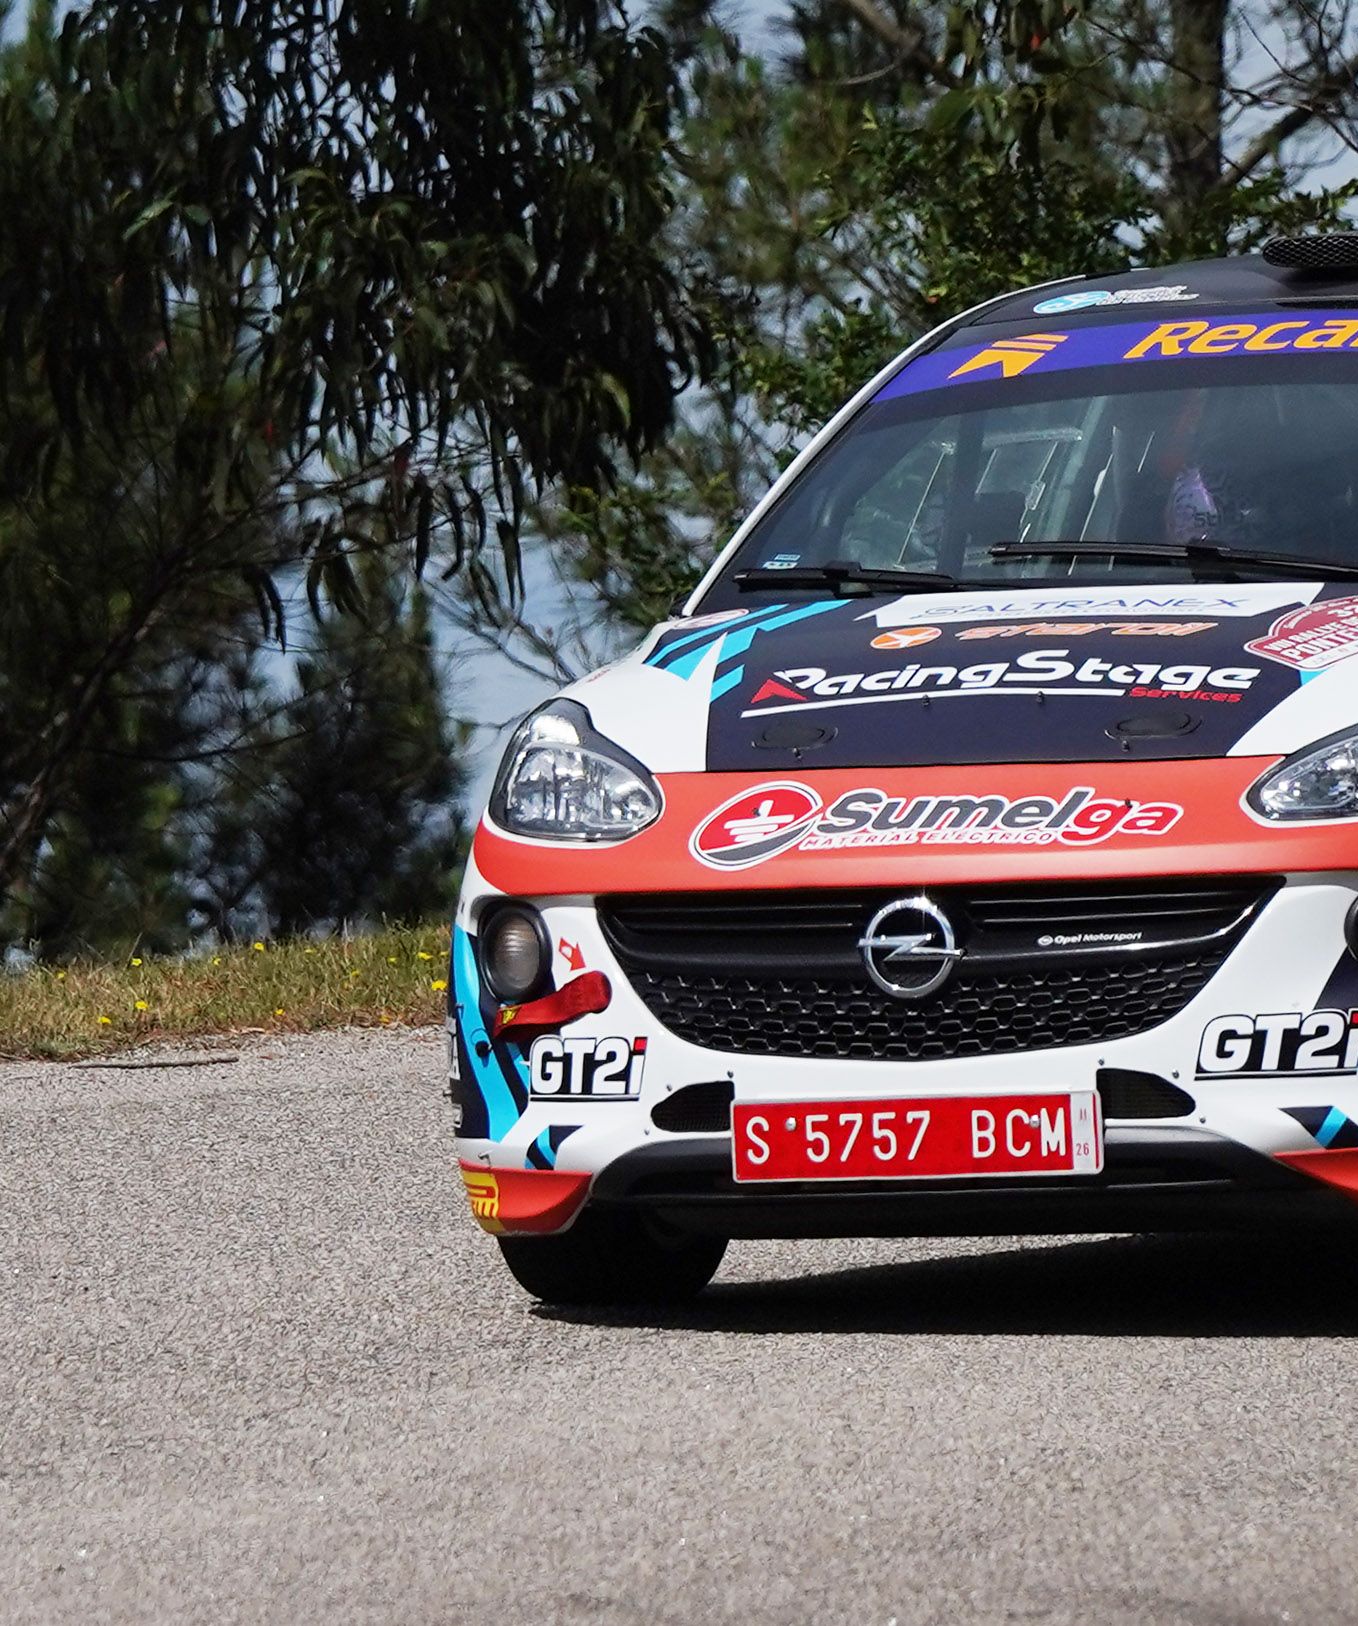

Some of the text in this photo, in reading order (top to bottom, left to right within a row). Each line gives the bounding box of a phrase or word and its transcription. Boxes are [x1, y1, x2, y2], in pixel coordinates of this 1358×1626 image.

[911, 598, 1249, 618] SALTRANEX
[1129, 686, 1242, 704] Services
[816, 786, 1184, 846] Sumelga
[802, 831, 916, 849] MATERIAL
[1054, 931, 1142, 945] Opel Motorsport
[529, 1036, 649, 1096] GT2i
[744, 1105, 1067, 1165] S 5757 BCM
[1075, 1142, 1090, 1156] 26
